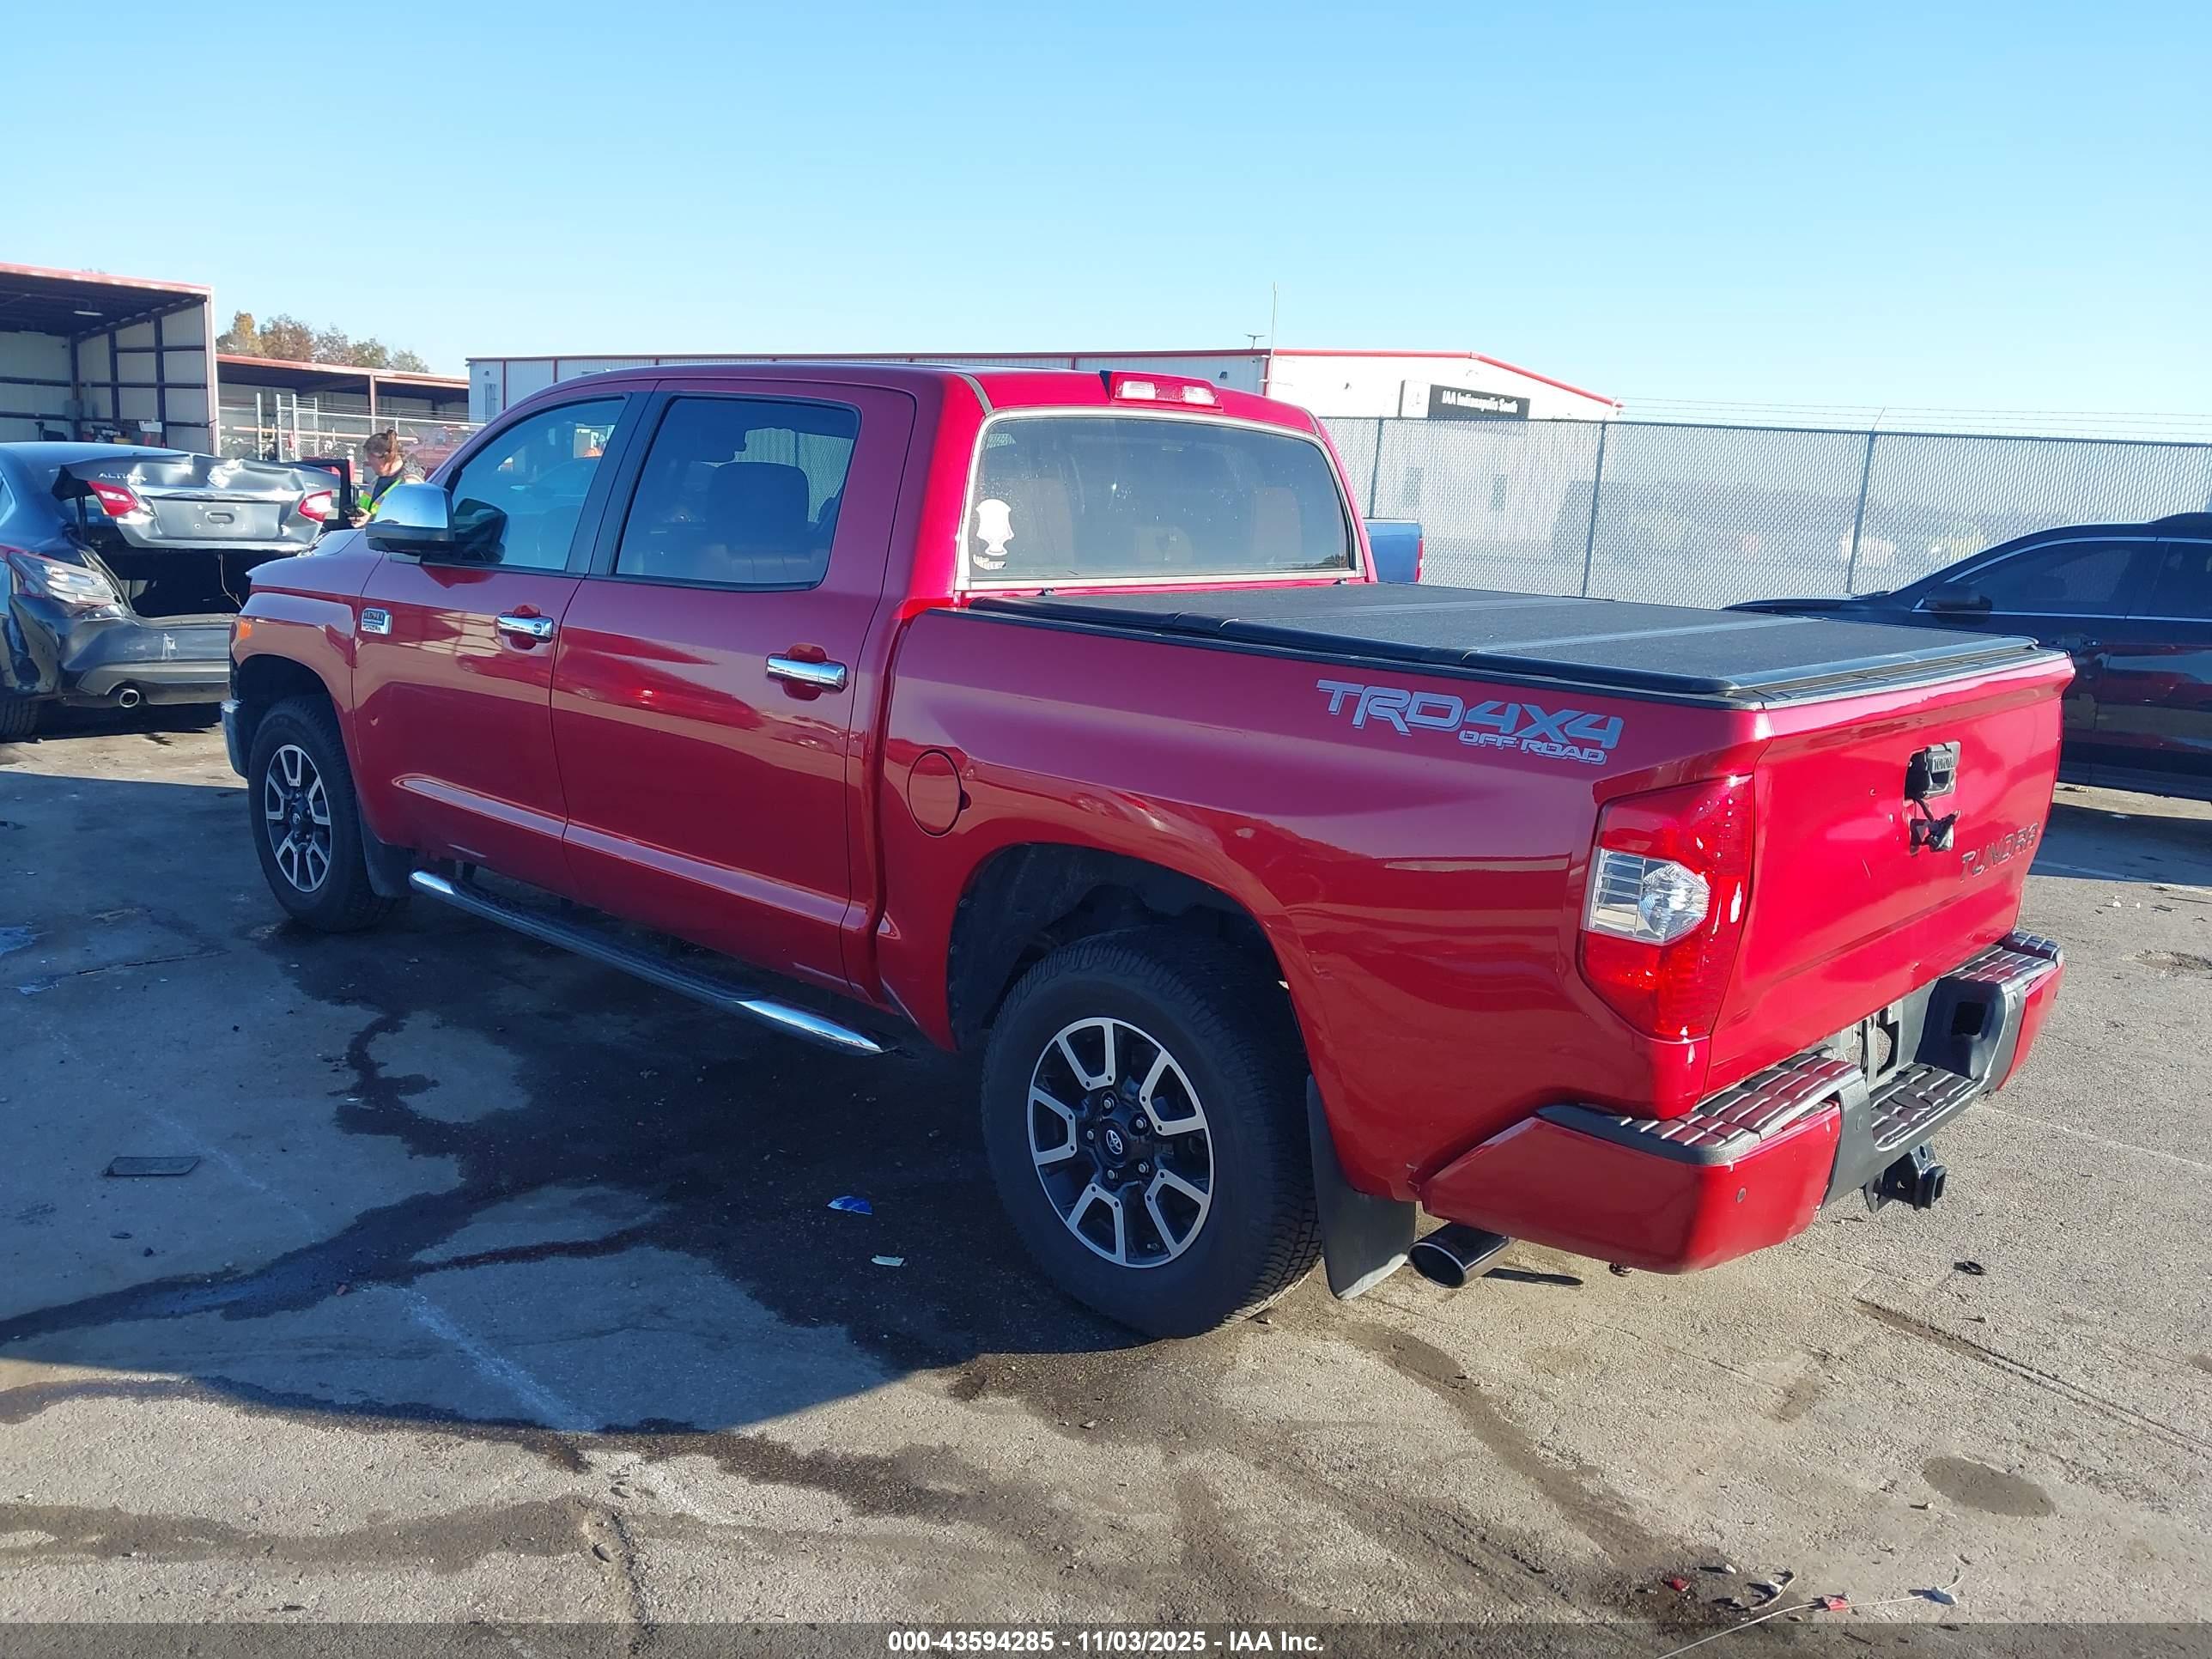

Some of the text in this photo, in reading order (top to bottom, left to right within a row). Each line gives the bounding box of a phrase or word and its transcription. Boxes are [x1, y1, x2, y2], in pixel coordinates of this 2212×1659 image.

[1442, 390, 1456, 405] IAA
[1316, 678, 1466, 737] TRD
[1458, 729, 1608, 766] OFF ROAD
[1959, 823, 2041, 884] TUNDRA
